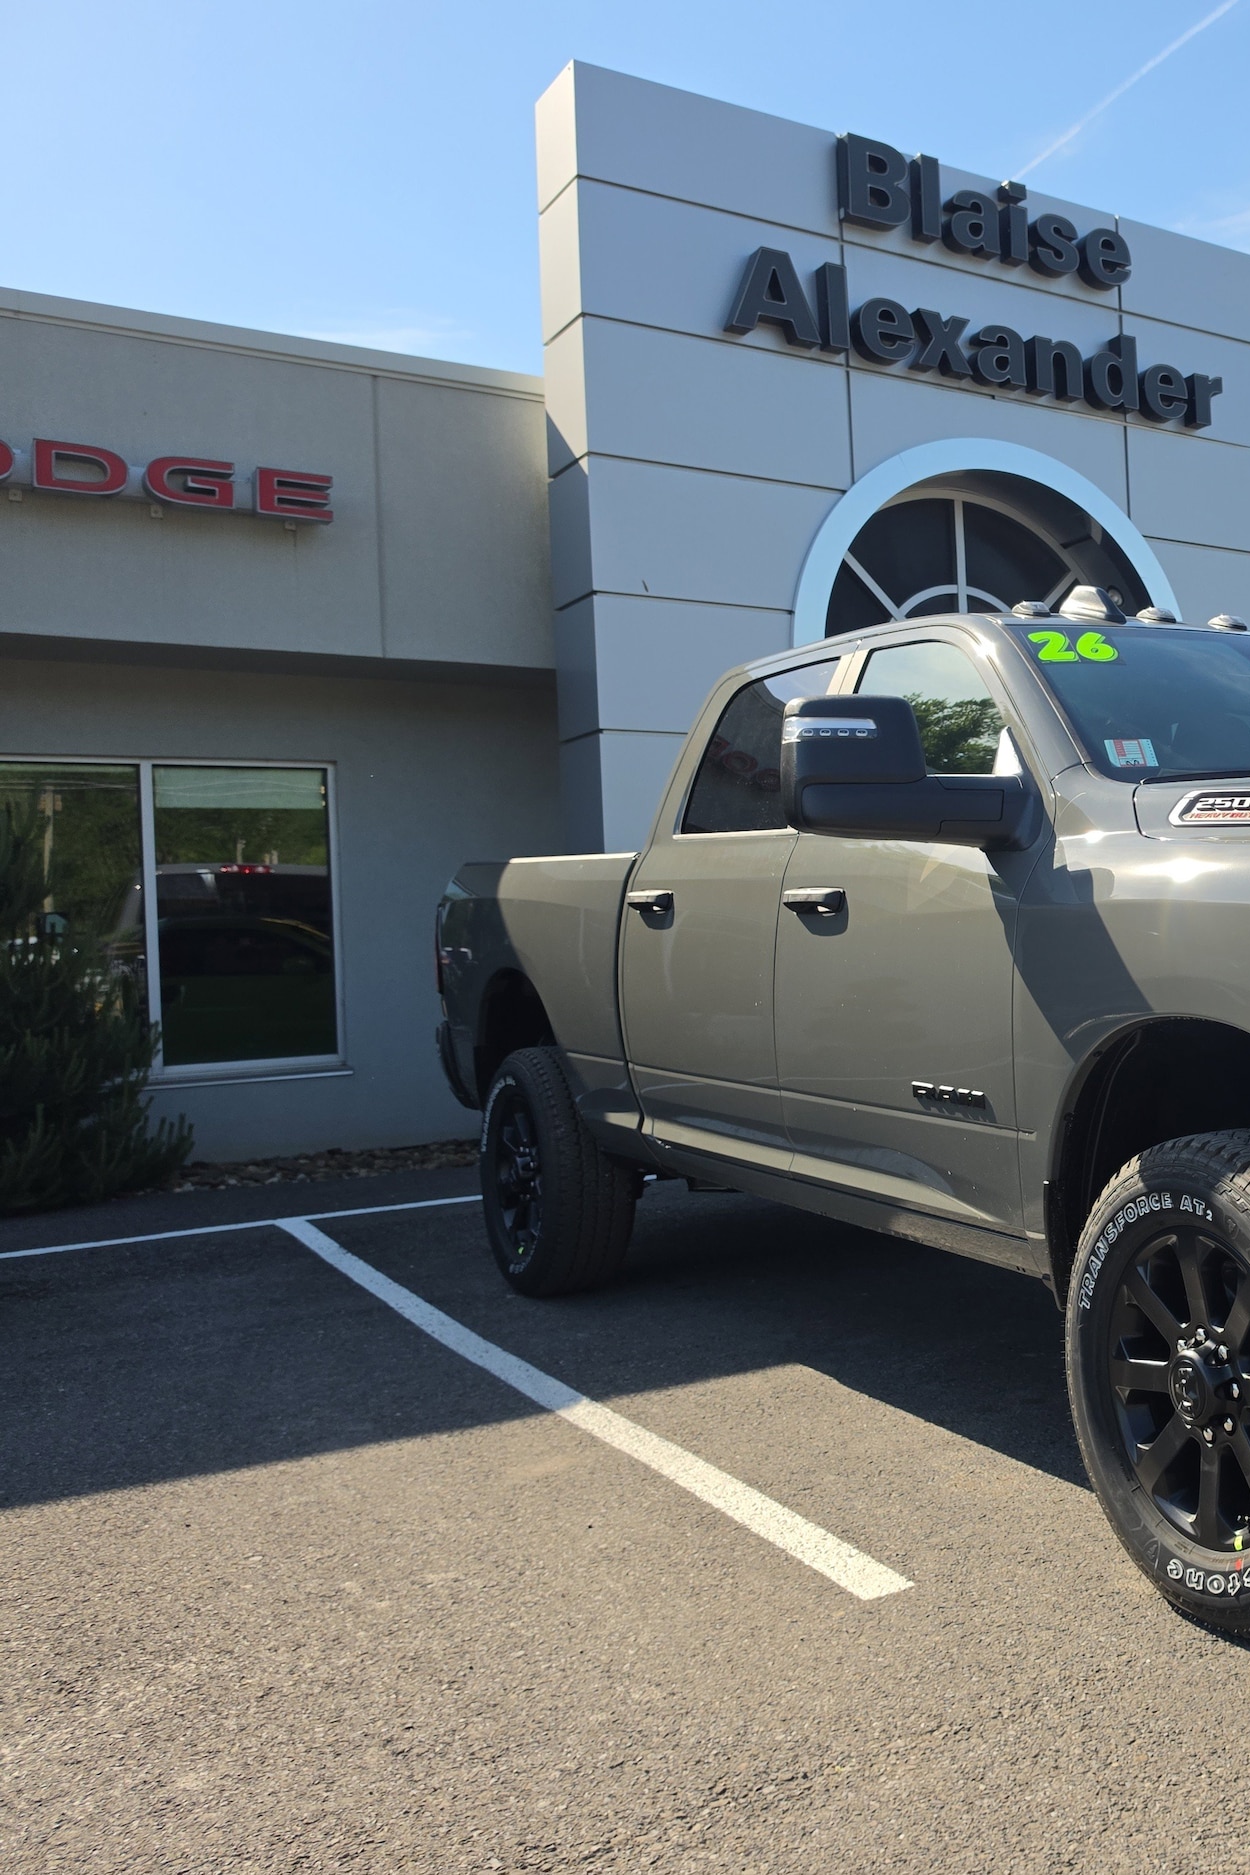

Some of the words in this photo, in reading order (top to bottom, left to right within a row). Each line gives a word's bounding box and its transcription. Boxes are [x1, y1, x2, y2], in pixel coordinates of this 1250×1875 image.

[836, 132, 1132, 291] Blaise
[723, 246, 1223, 430] Alexander
[0, 437, 334, 525] DGE
[1027, 630, 1118, 663] 26
[911, 1081, 986, 1110] RAM
[1078, 1192, 1174, 1310] TRANSFORCE
